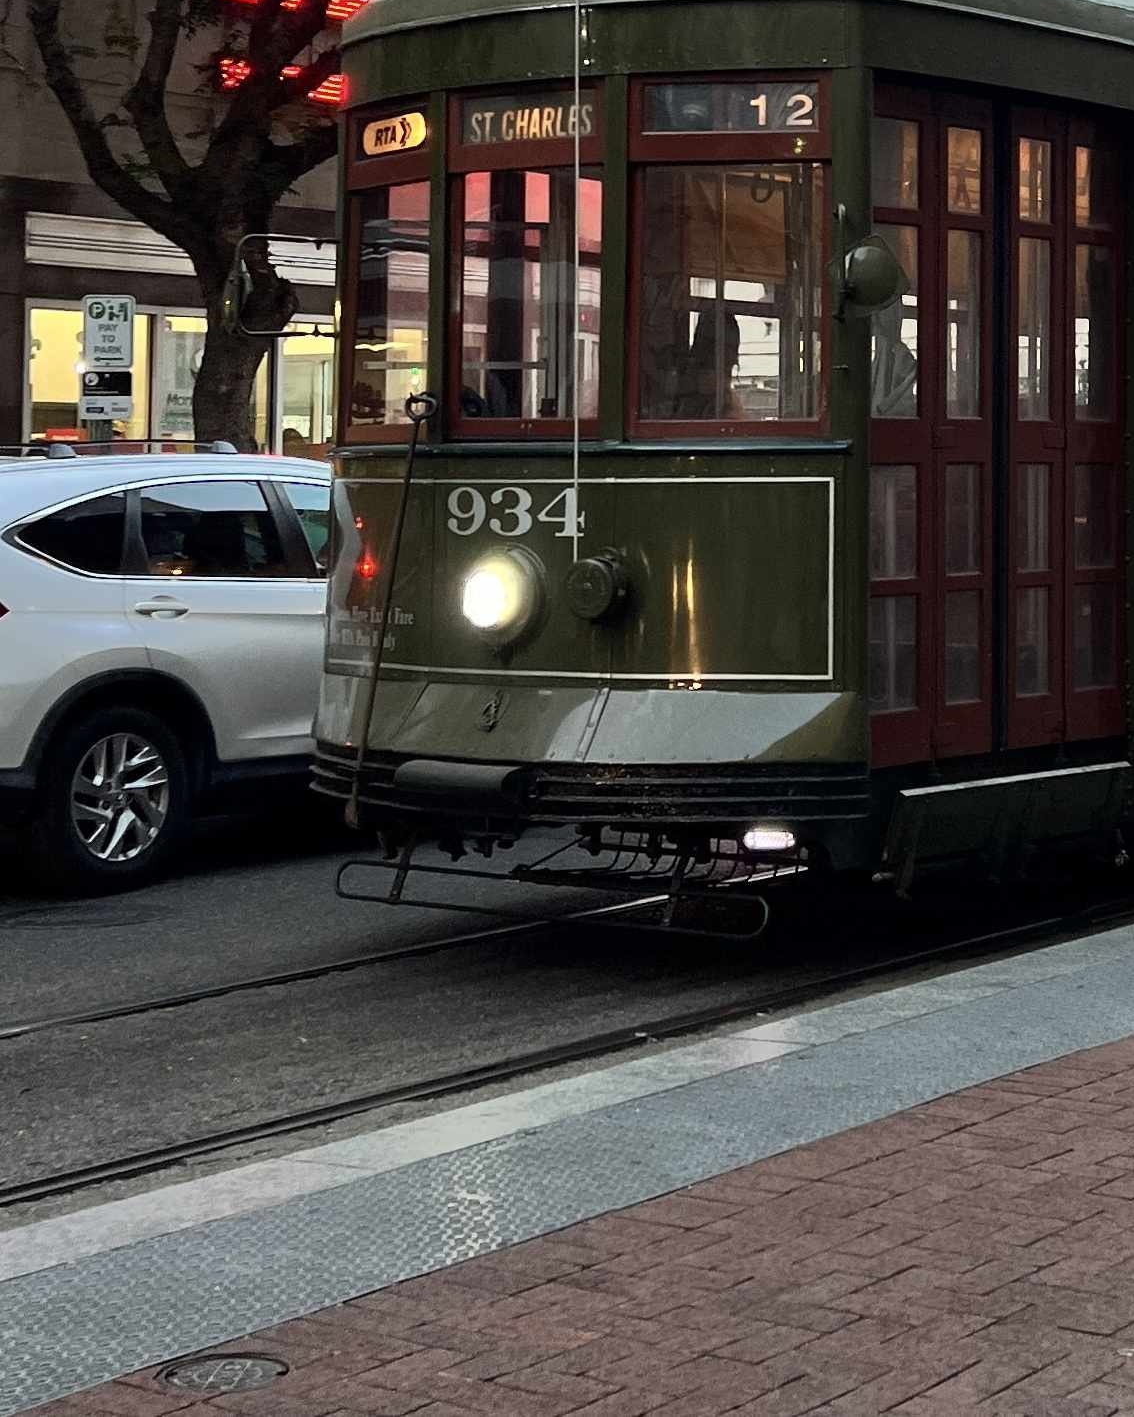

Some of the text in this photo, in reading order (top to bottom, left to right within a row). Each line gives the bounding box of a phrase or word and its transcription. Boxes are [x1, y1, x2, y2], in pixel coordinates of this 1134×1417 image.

[471, 104, 593, 143] ST. CHARLES
[374, 125, 397, 147] RTA
[98, 323, 118, 332] PAY
[102, 334, 115, 343] TO
[94, 345, 122, 354] PARK
[448, 486, 586, 537] 934
